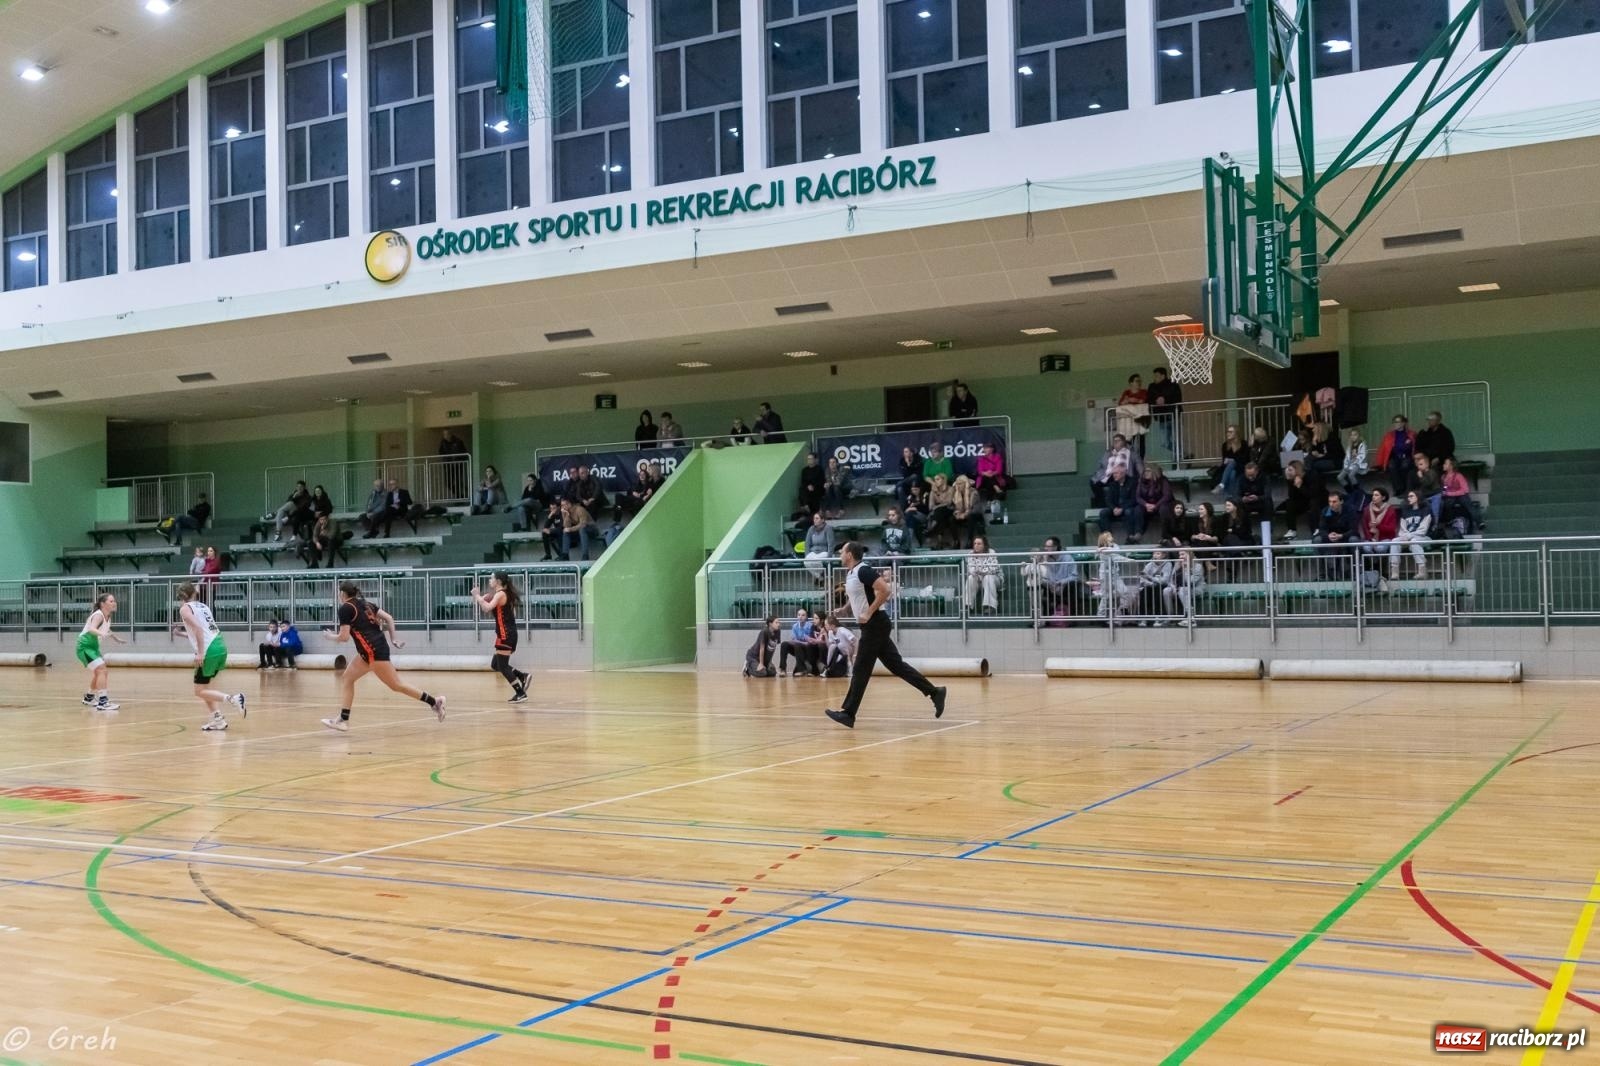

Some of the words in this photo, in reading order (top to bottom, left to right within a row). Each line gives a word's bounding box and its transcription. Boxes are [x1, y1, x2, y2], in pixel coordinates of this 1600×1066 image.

[417, 221, 520, 260] OŚRODEK
[528, 205, 622, 244] SPORTU
[631, 203, 637, 228] I
[647, 180, 784, 226] REKREACJI
[796, 156, 936, 204] RACIBÓRZ
[1055, 360, 1065, 370] F
